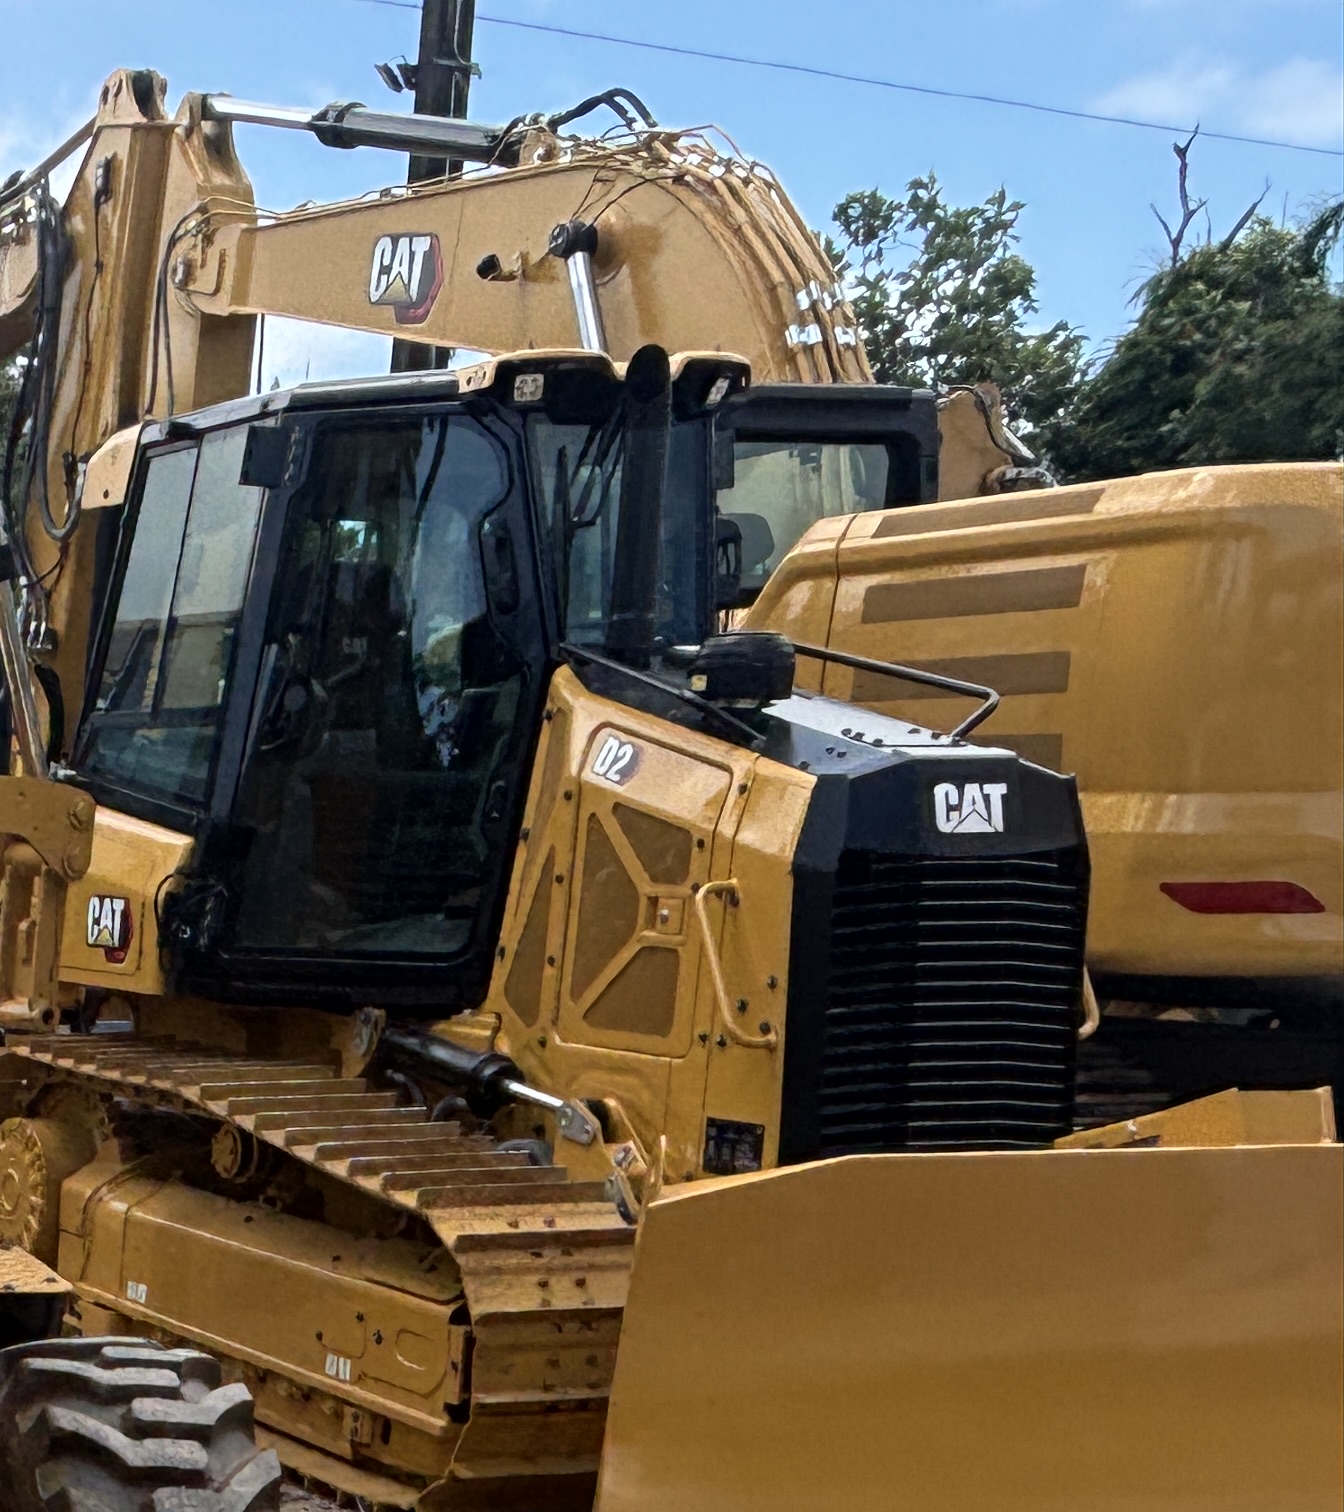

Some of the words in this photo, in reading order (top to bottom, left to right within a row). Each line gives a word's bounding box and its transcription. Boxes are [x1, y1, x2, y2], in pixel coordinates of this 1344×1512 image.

[370, 235, 431, 303] CAT
[592, 736, 634, 782] D2
[933, 782, 1008, 833] CAT
[87, 896, 125, 948] CAT
